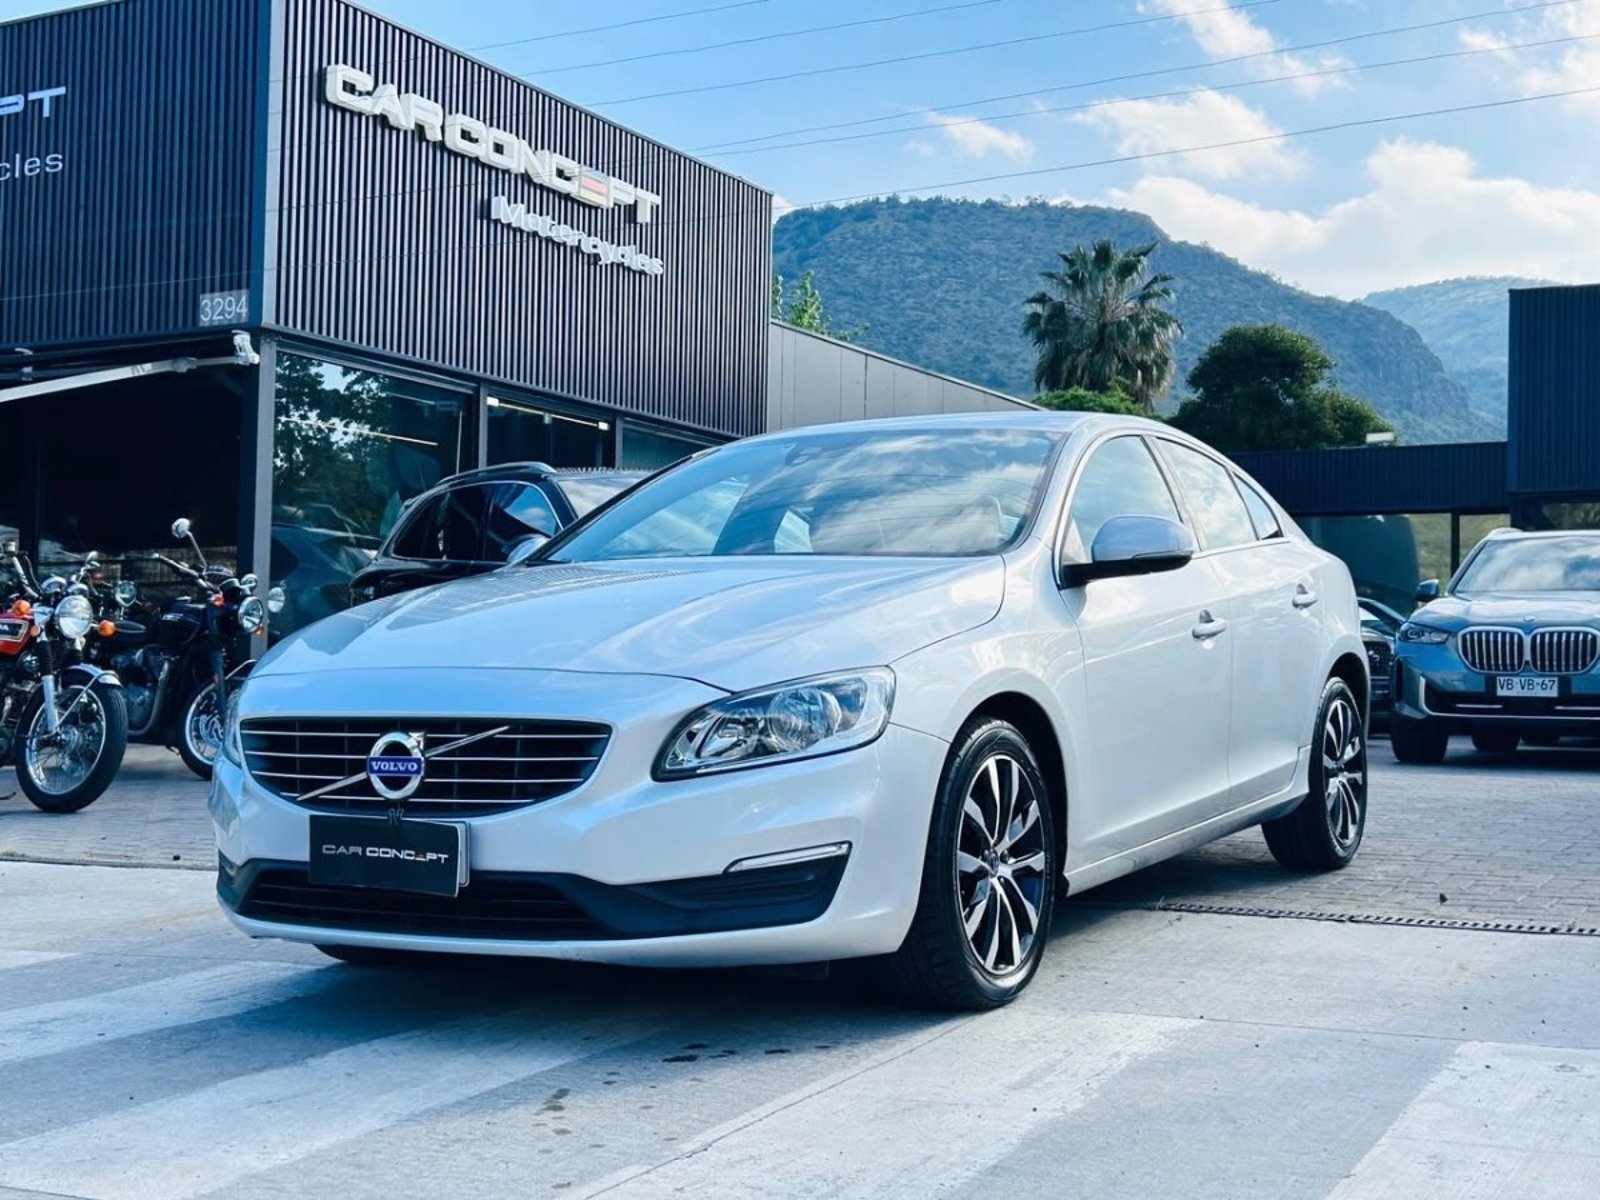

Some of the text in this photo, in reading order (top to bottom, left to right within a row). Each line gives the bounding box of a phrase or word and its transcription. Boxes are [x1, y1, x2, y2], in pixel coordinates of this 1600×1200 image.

[325, 63, 443, 142] CAR
[490, 196, 663, 275] Motorcycles
[200, 296, 248, 321] 3294
[371, 760, 418, 771] VOLVO
[322, 844, 362, 855] CAR
